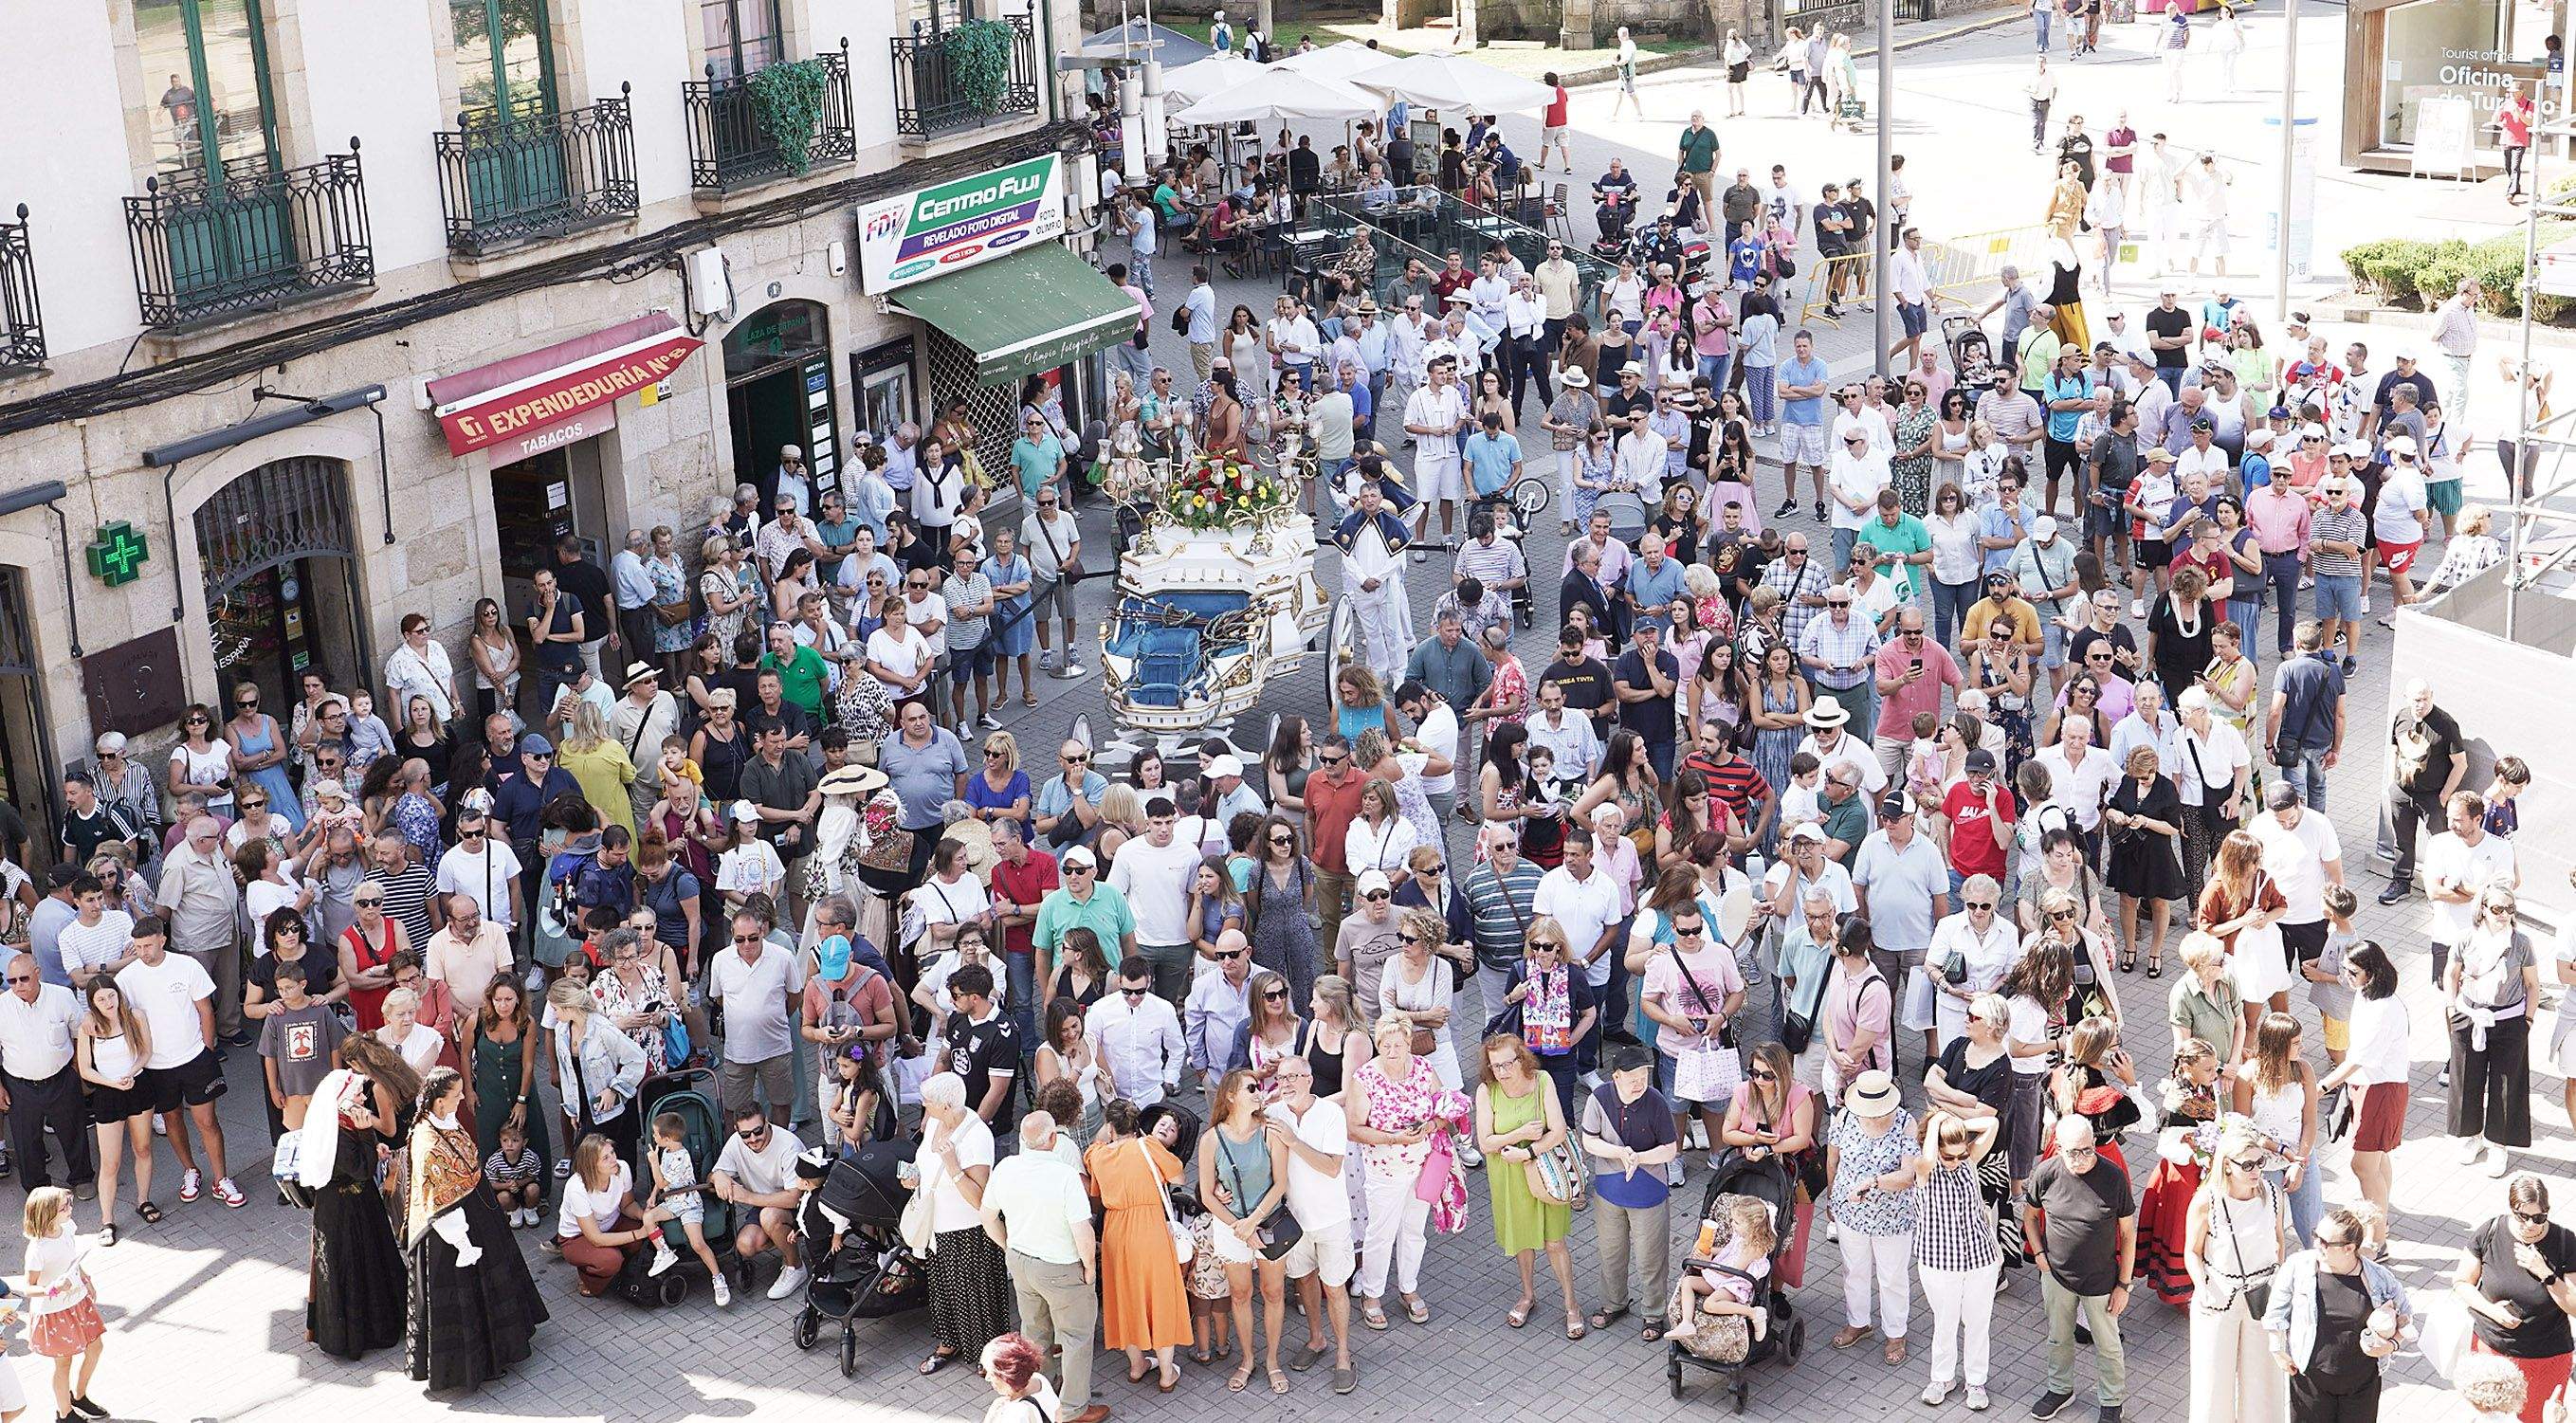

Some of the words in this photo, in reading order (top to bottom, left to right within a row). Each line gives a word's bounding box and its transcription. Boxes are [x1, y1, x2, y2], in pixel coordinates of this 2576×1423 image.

[2440, 46, 2478, 61] Tourist
[2439, 65, 2513, 87] Oficina
[1035, 219, 1062, 235] OLIMPIO
[1039, 209, 1056, 221] FOTO
[923, 226, 967, 248] REVELADO
[967, 218, 989, 237] FOTO
[990, 210, 1020, 229] DIGITAL
[488, 364, 651, 435] EXPENDEDURÍA
[521, 422, 584, 455] TABACOS
[219, 637, 252, 669] ESPAÑA
